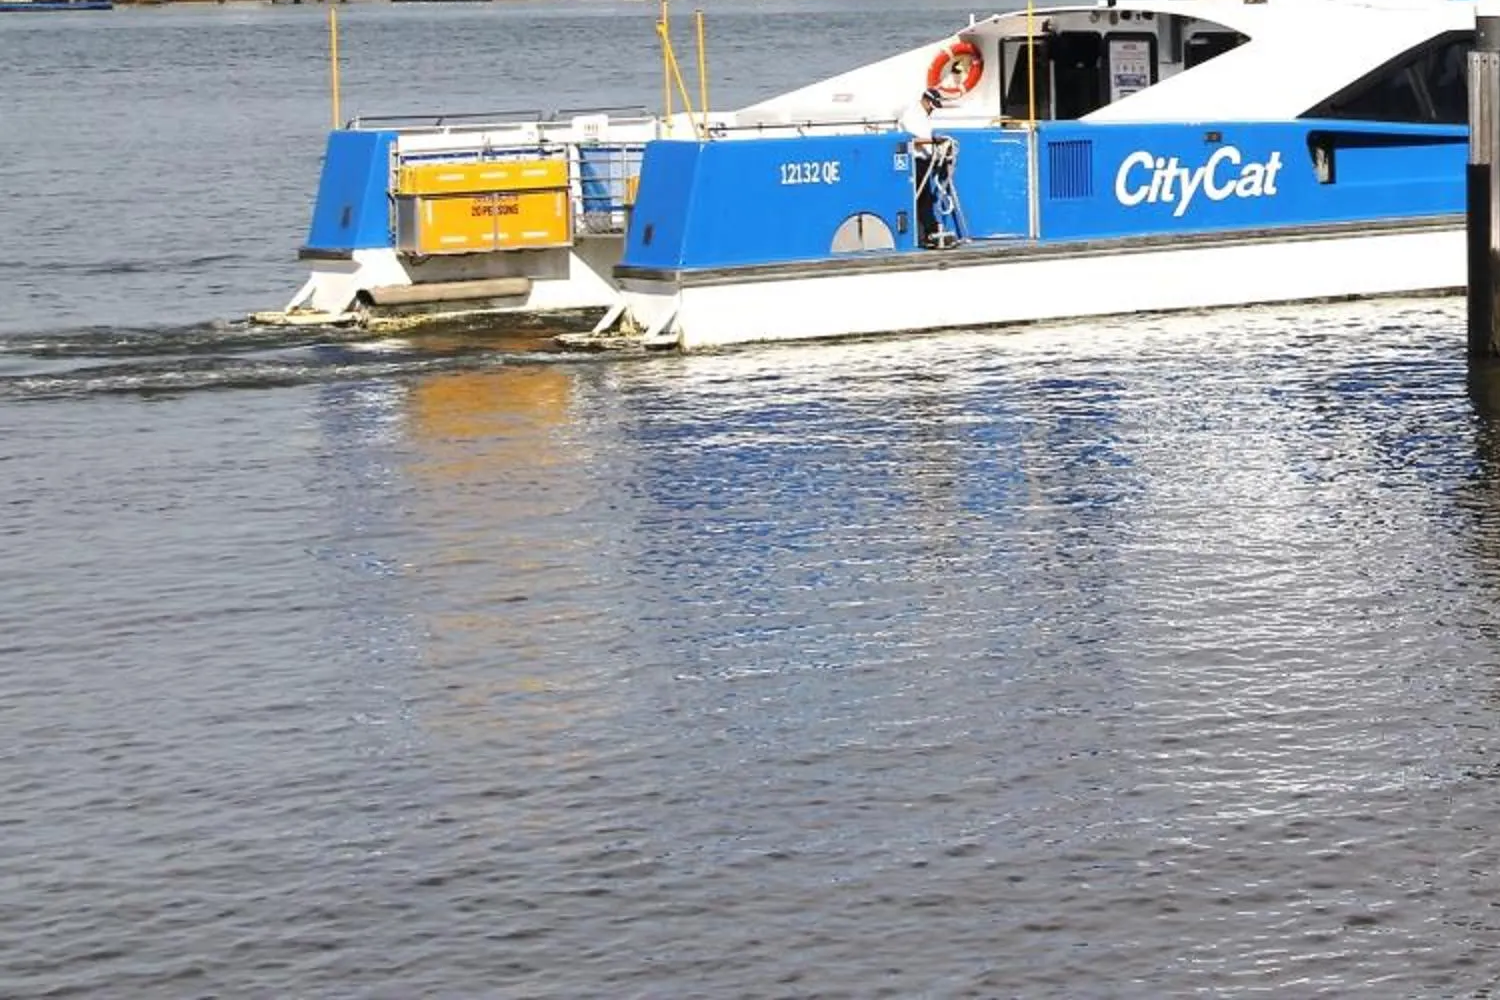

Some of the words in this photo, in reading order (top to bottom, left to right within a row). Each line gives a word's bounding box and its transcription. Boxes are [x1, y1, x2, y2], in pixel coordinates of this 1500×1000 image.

[781, 163, 820, 185] 12132
[822, 161, 841, 185] QE
[1115, 145, 1283, 217] CityCat
